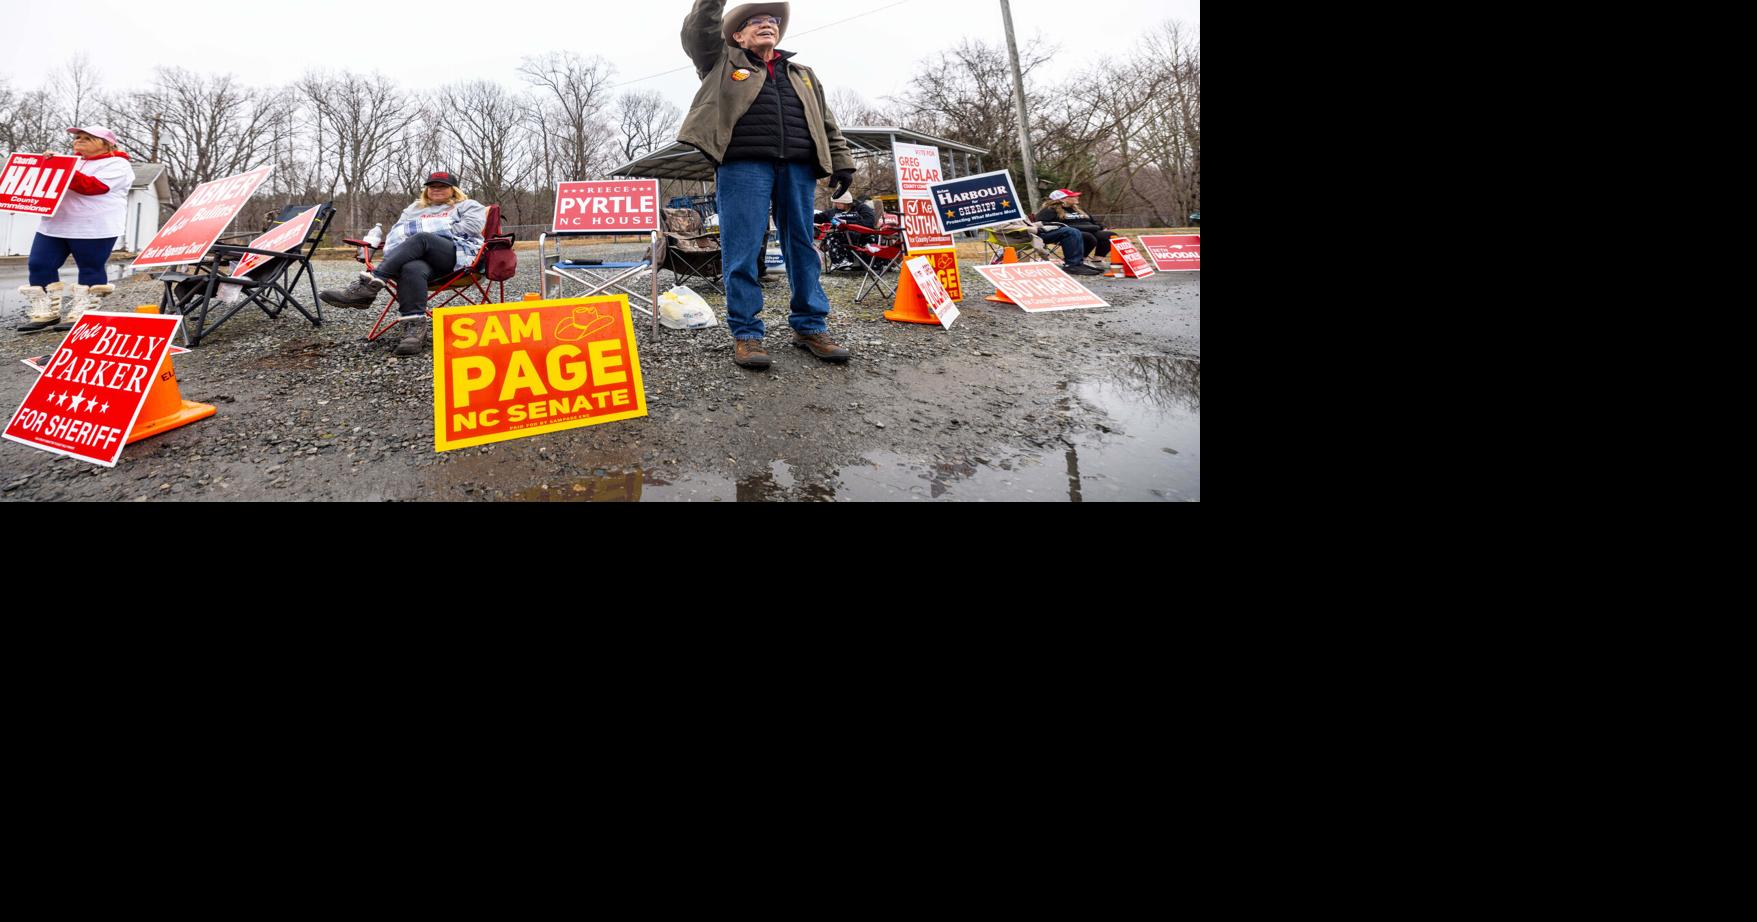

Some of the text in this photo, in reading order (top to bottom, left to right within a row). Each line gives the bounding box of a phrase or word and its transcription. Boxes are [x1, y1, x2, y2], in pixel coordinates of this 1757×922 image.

[13, 156, 38, 165] Charlie
[899, 156, 919, 166] GREG
[0, 165, 65, 199] HALL
[900, 168, 940, 182] ZIGLAR
[10, 196, 39, 204] County
[184, 173, 257, 208] ABNER
[938, 186, 1008, 205] HARBOUR
[0, 202, 51, 212] ommissioner
[191, 204, 235, 222] Bullins
[560, 196, 654, 214] PYRTLE
[959, 202, 996, 216] SHERIFF
[905, 215, 941, 235] SUTHA
[946, 217, 971, 225] Protecting
[936, 269, 957, 289] GE
[1012, 267, 1055, 277] Kevin
[1000, 277, 1086, 297] SUTHARD
[451, 312, 542, 349] SAM
[72, 323, 165, 360] Vote BILLY
[45, 348, 148, 393] PARKER
[452, 339, 627, 408] PAGE
[453, 389, 629, 432] NC SENATE
[14, 408, 47, 432] FOR
[45, 415, 121, 450] SHERIFF
